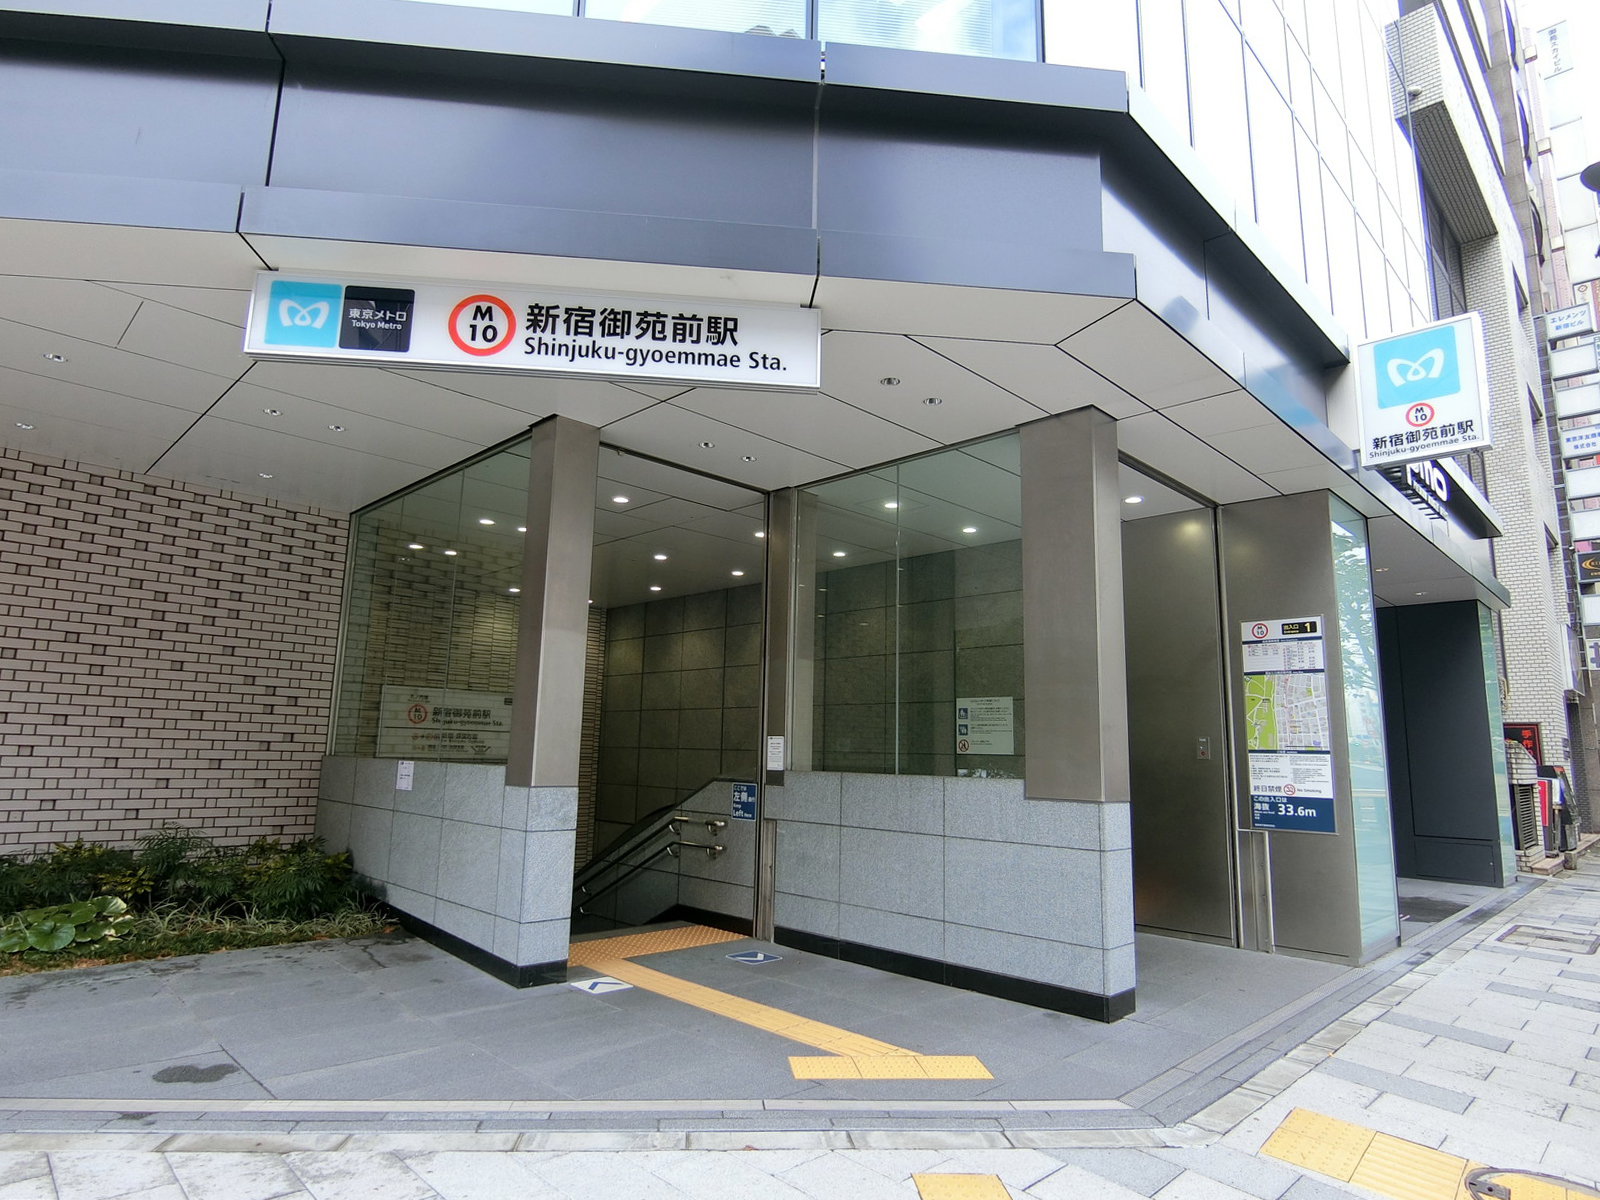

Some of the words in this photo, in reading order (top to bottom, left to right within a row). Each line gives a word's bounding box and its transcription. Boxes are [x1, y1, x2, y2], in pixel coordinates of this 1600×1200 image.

[349, 308, 407, 321] 東京メトロ
[472, 305, 493, 322] M
[352, 320, 376, 330] Tokyo
[377, 321, 402, 330] Metro
[525, 303, 738, 346] 新宿御苑前駅
[469, 324, 498, 343] 10
[524, 337, 741, 367] Shinjuku-gyoemmae
[749, 352, 787, 371] Sta.
[1414, 414, 1428, 422] 10
[1372, 419, 1474, 450] 新宿御苑前駅
[1369, 437, 1460, 459] Shinjuku-gyoemmae
[1462, 434, 1480, 443] Sta.
[1304, 622, 1311, 633] 1
[1253, 785, 1282, 793] 終日禁煙
[1277, 803, 1317, 817] 33.6m
